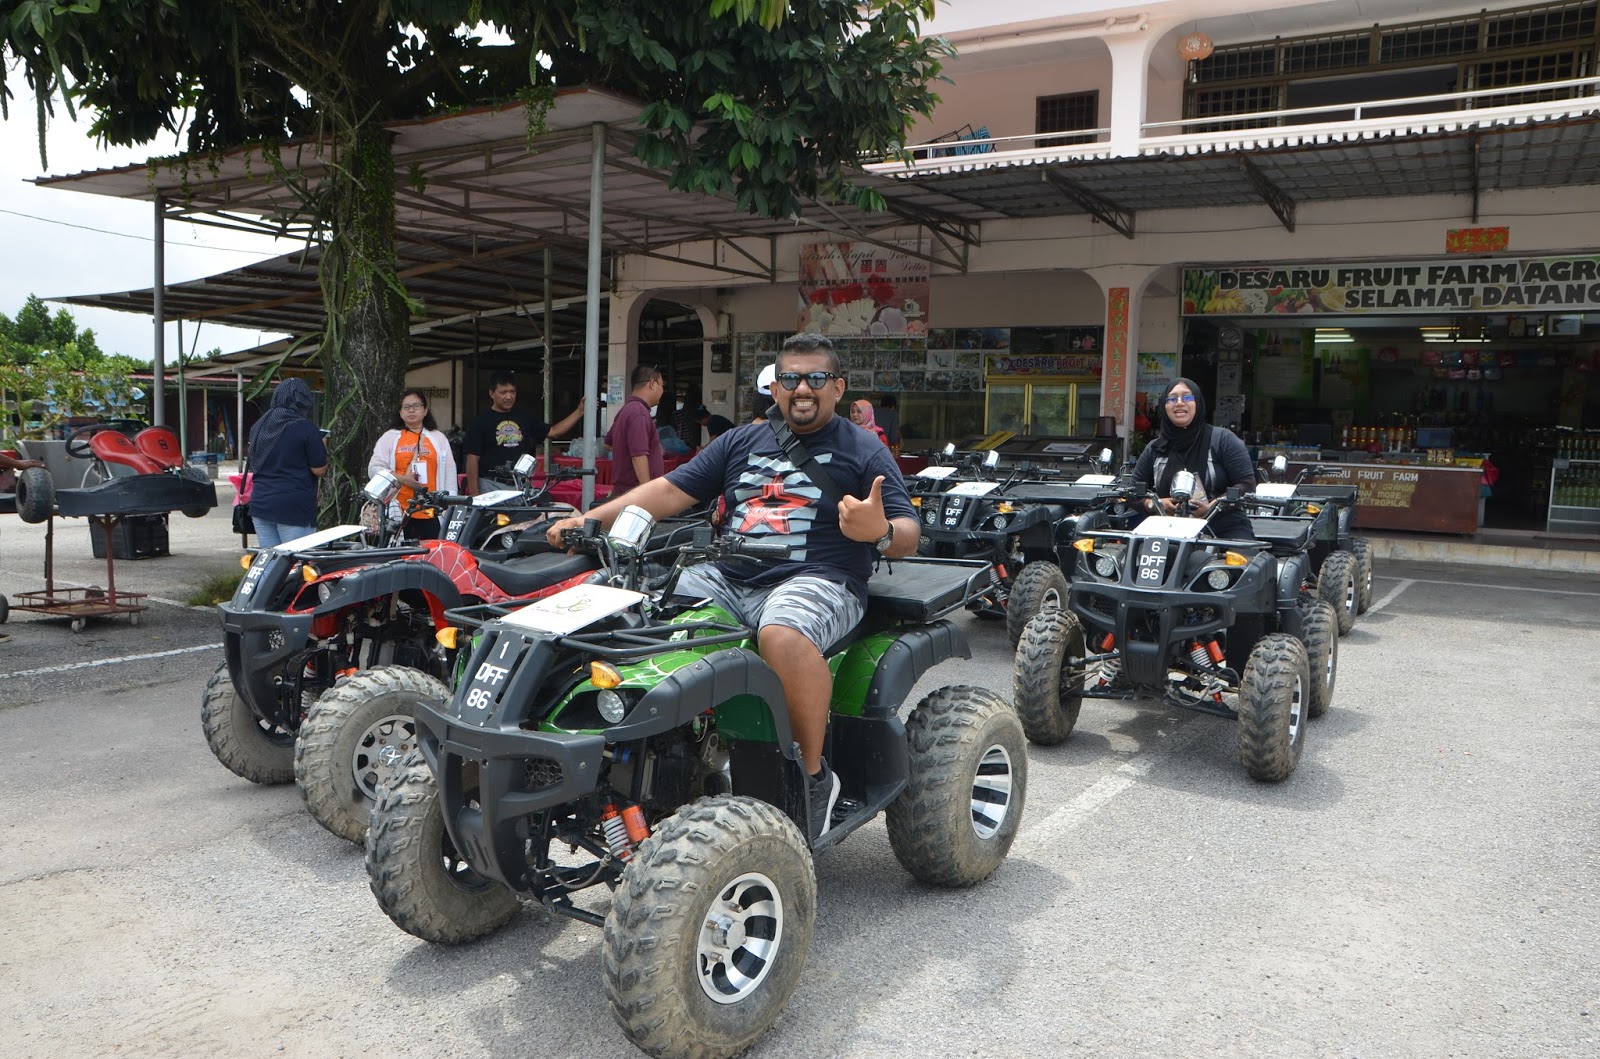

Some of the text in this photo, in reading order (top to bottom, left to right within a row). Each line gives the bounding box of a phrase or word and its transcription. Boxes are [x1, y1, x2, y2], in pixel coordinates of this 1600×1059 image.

[1220, 260, 1600, 290] DESARU FRUIT FARM AGR
[1344, 287, 1475, 308] SELAMAT
[1016, 358, 1055, 368] DESARU
[1358, 471, 1385, 480] FRUIT
[1393, 472, 1419, 482] FARM
[1377, 491, 1402, 500] MORE
[953, 498, 960, 507] 9
[1370, 499, 1410, 508] TROPICAL
[456, 510, 463, 519] 7
[945, 508, 963, 517] DFF
[448, 520, 463, 530] DFF
[945, 517, 957, 525] 86
[446, 531, 458, 541] 86
[1151, 541, 1161, 553] 6
[258, 553, 269, 566] 3
[1140, 555, 1167, 567] DFF
[247, 565, 264, 580] DFF
[1140, 567, 1159, 580] 86
[240, 581, 254, 595] 86
[499, 640, 510, 660] 1
[474, 662, 510, 686] DFF
[466, 687, 492, 710] 86
